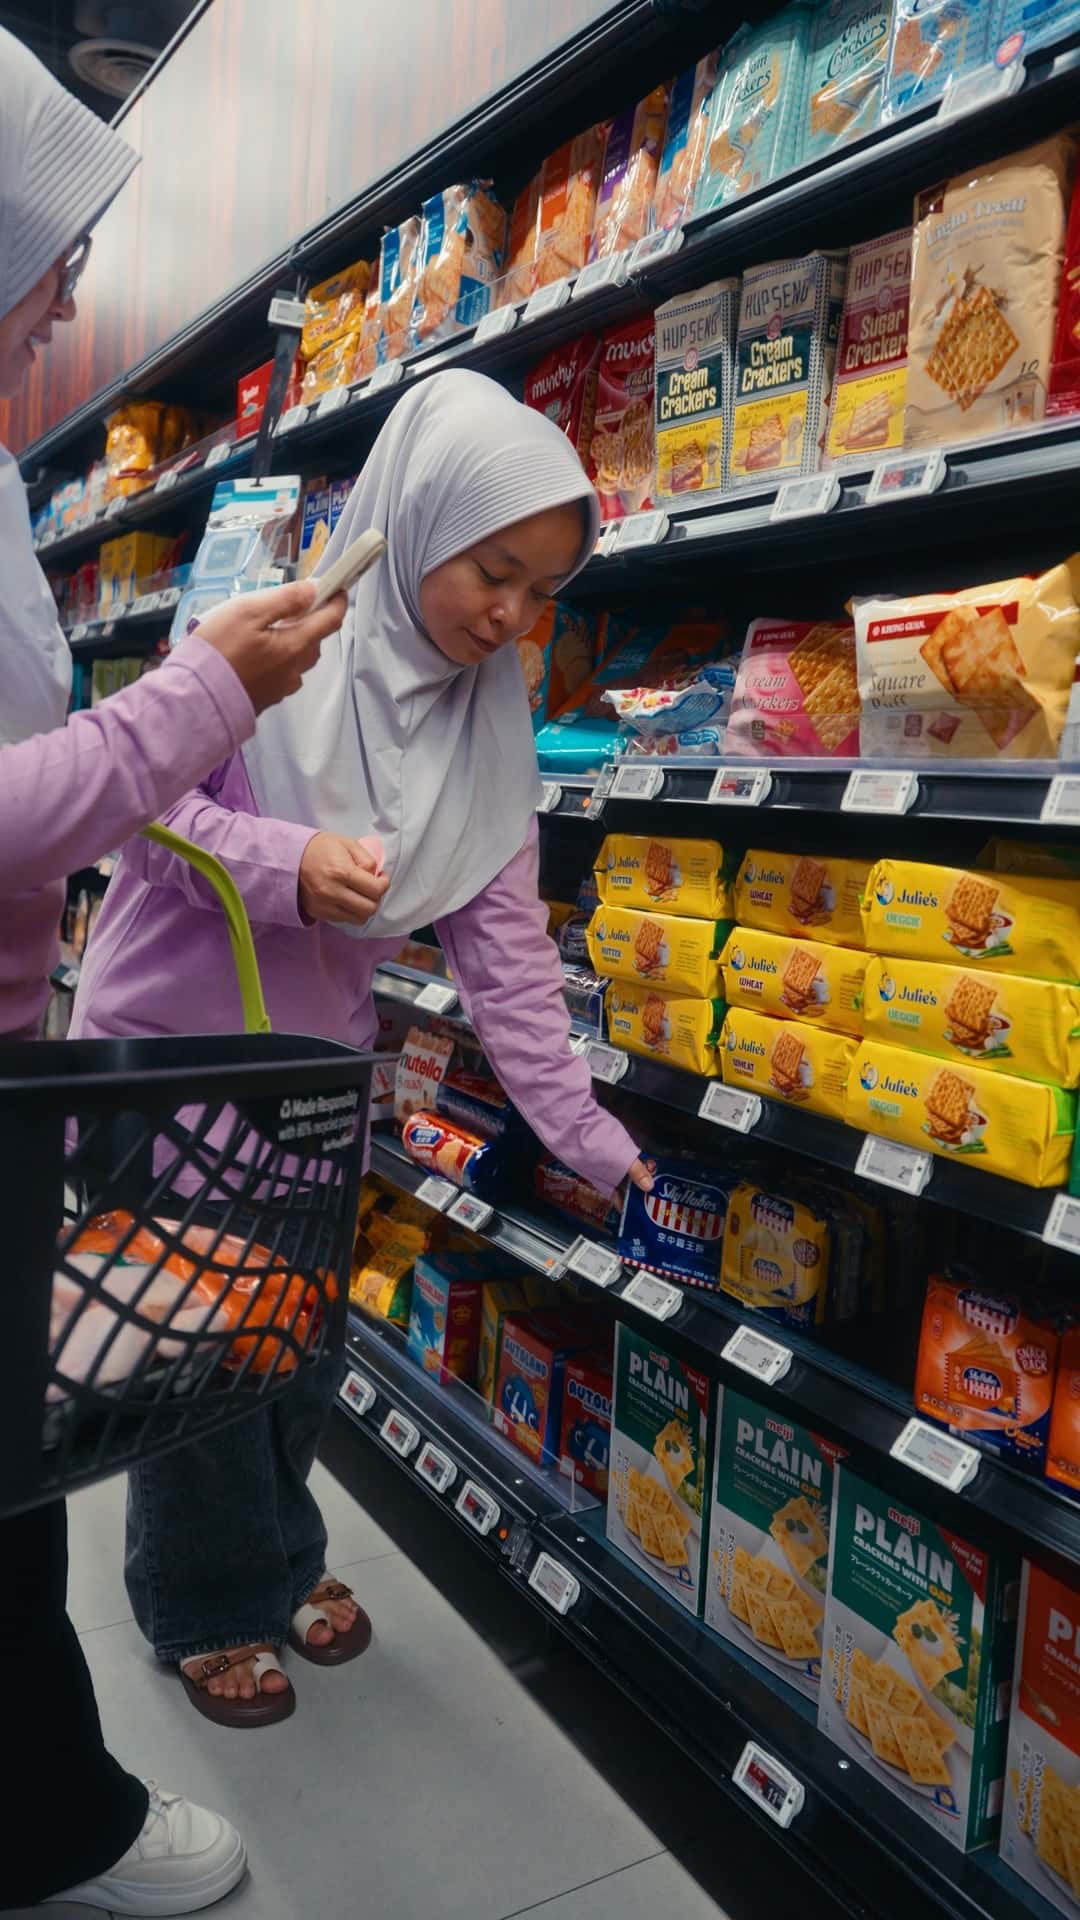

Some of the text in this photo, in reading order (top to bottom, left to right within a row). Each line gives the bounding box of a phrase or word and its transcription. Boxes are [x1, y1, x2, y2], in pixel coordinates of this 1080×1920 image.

[853, 248, 912, 290] HUP SEN
[744, 277, 809, 319] HUP SENG
[662, 314, 718, 351] HUP SENG
[860, 308, 905, 340] Sugar
[750, 335, 793, 366] Cream
[845, 334, 908, 370] Cracker
[531, 360, 578, 401] munchy's
[668, 367, 709, 396] Cream
[741, 356, 803, 393] Crackers
[660, 386, 717, 420] Crackers
[869, 673, 926, 696] Square
[616, 856, 641, 869] Julie's
[756, 870, 785, 885] Julie's
[750, 889, 774, 902] WHEAT
[896, 888, 939, 908] Julie's
[607, 928, 631, 943] Julie's
[747, 959, 778, 974] Julie's
[739, 976, 764, 991] WHEAT
[898, 987, 938, 1006] Julie's
[737, 1040, 766, 1057] Julie's
[400, 1053, 443, 1082] nutella
[732, 1058, 755, 1072] WHEAT
[879, 1079, 919, 1098] Julie's
[292, 1097, 316, 1118] Made
[658, 1181, 719, 1212] SkyFlakes
[567, 1378, 614, 1413] AUTOL
[628, 1351, 690, 1410] PLAIN
[765, 1417, 795, 1441] meiji
[735, 1446, 777, 1475] CRACKERS
[776, 1469, 801, 1488] WITH
[737, 1418, 823, 1488] PLAIN
[887, 1506, 921, 1537] meiji
[853, 1535, 901, 1572] CRACKERS
[901, 1565, 928, 1591] WITH
[854, 1503, 954, 1593] PLAIN
